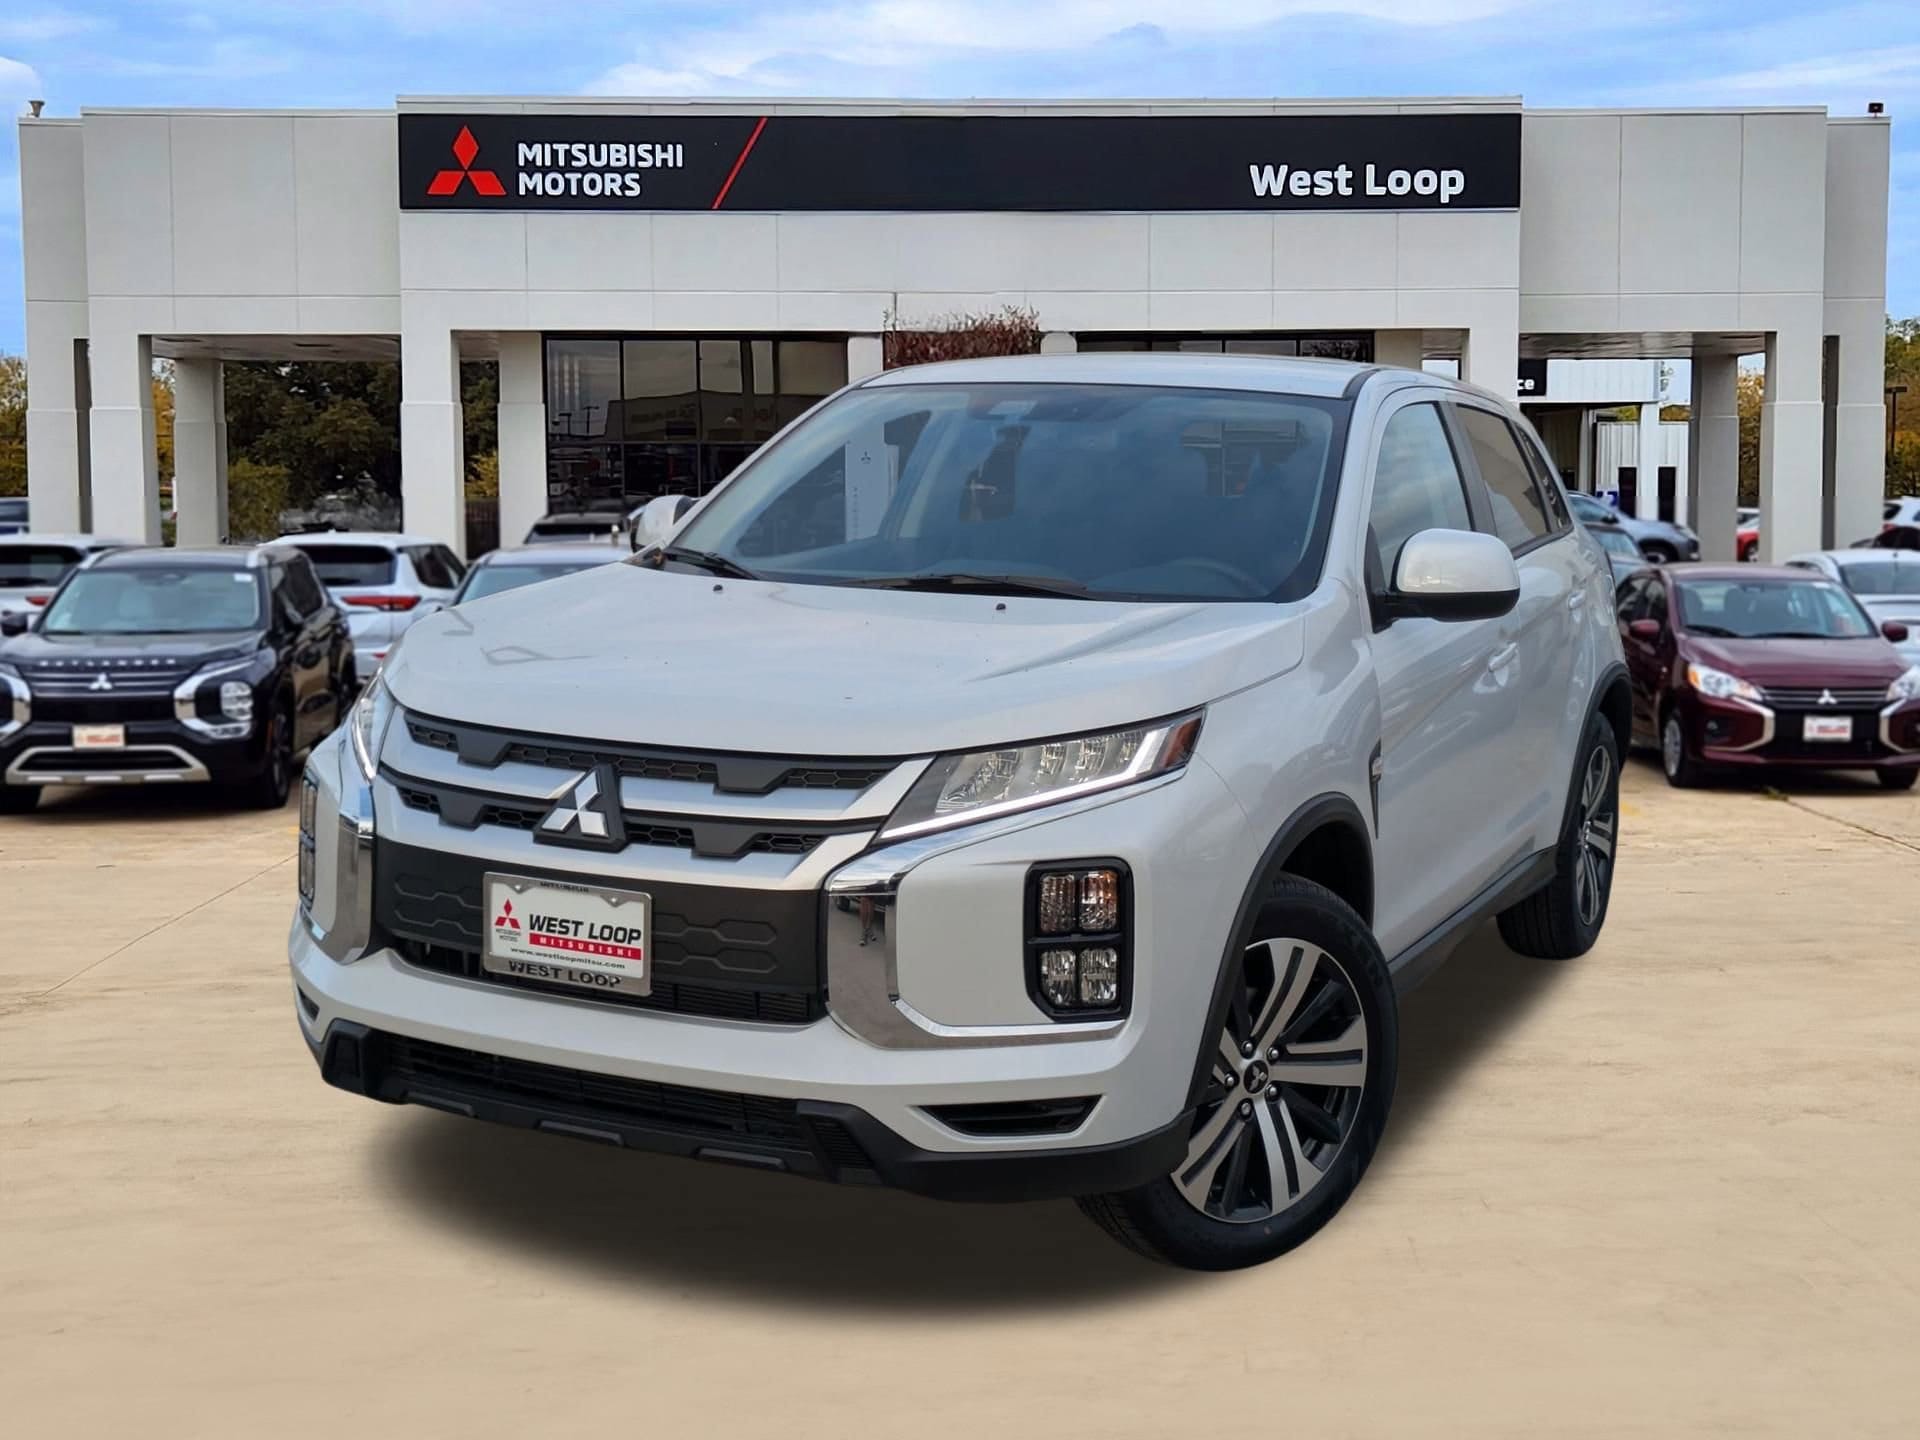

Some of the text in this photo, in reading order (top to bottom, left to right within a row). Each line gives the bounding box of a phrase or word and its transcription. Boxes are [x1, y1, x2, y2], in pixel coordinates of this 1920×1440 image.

[517, 142, 684, 168] MITSUBISHI
[518, 171, 641, 197] MOTORS
[1249, 163, 1465, 204] West Loop
[528, 913, 642, 945] WEST LOOP
[539, 936, 632, 957] MITSUBISHI
[508, 960, 621, 988] WEST LOOP
